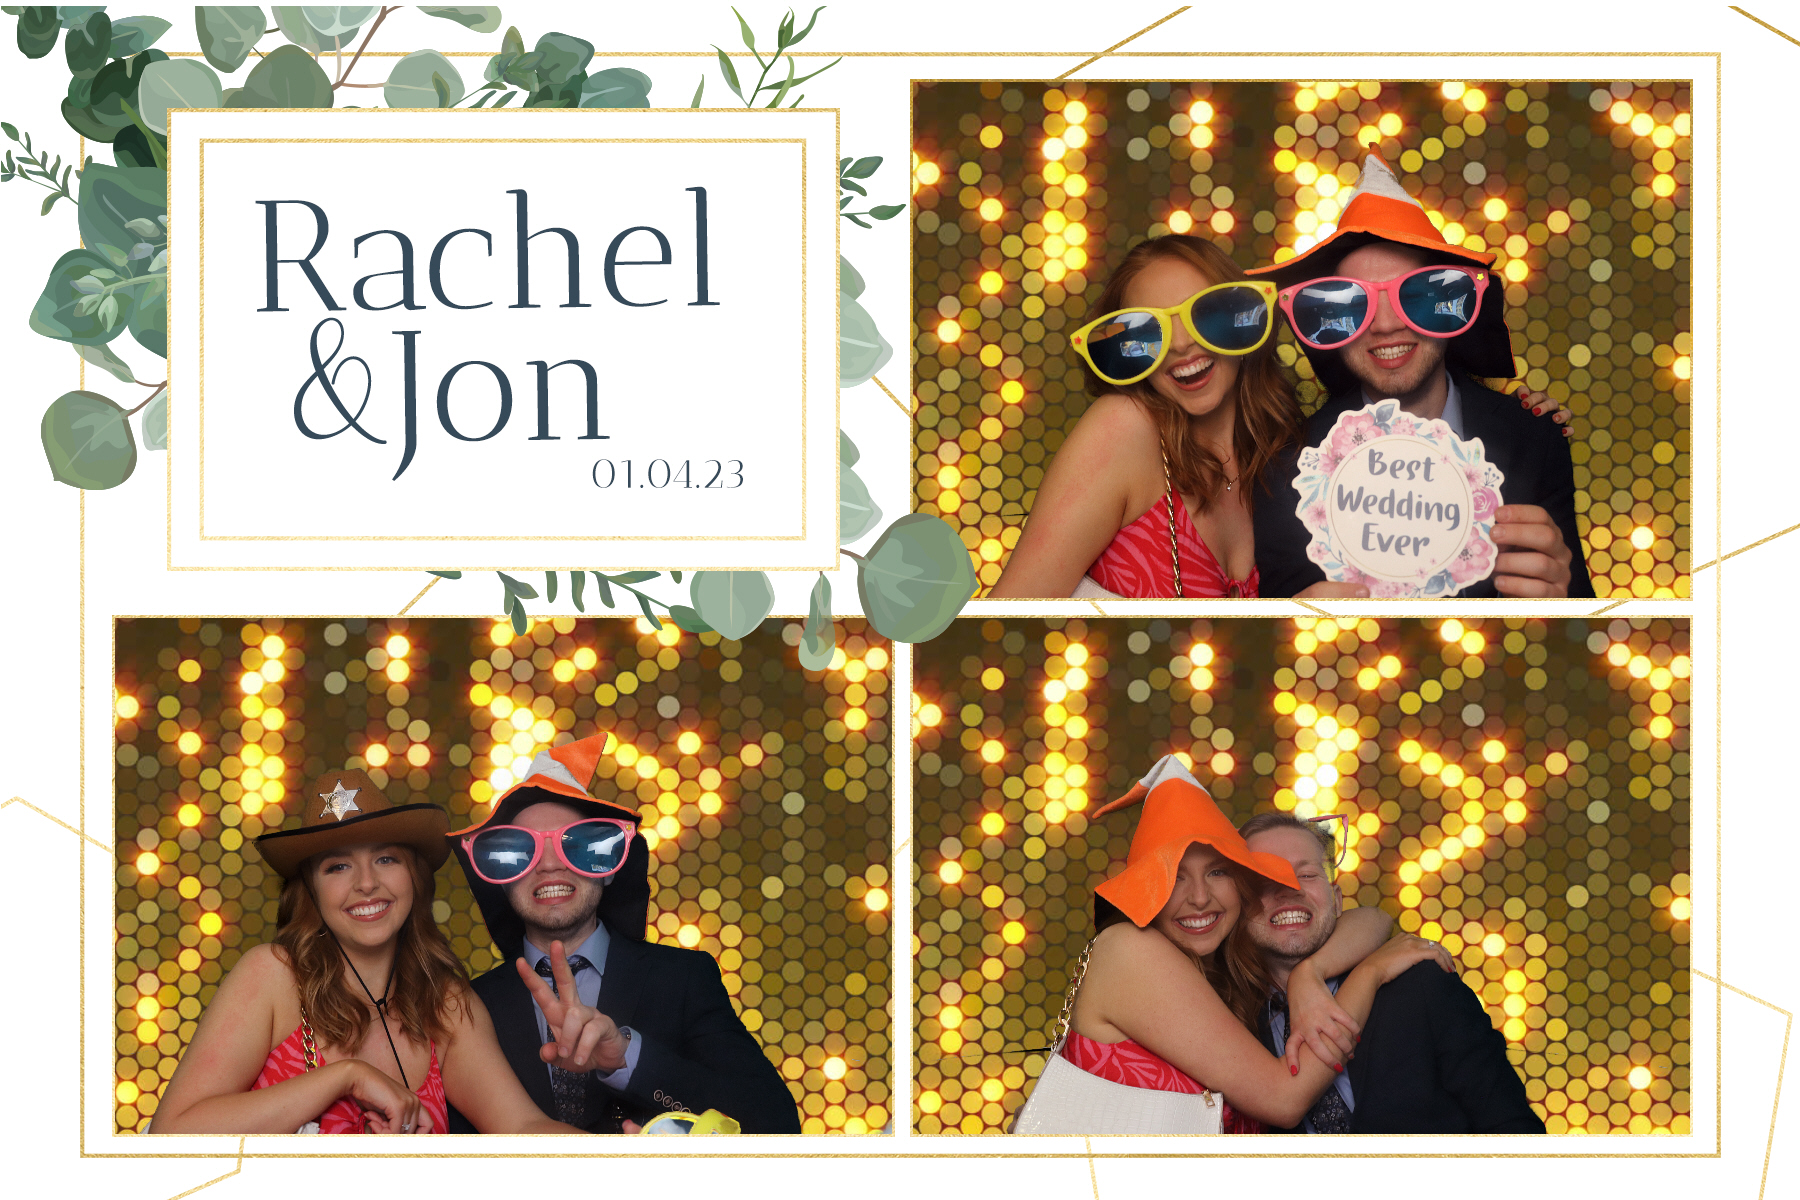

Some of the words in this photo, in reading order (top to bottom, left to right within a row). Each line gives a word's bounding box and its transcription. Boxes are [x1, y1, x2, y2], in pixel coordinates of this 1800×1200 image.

[1368, 448, 1436, 483] Best
[1336, 483, 1461, 531] Wedding
[1361, 522, 1431, 557] Ever
